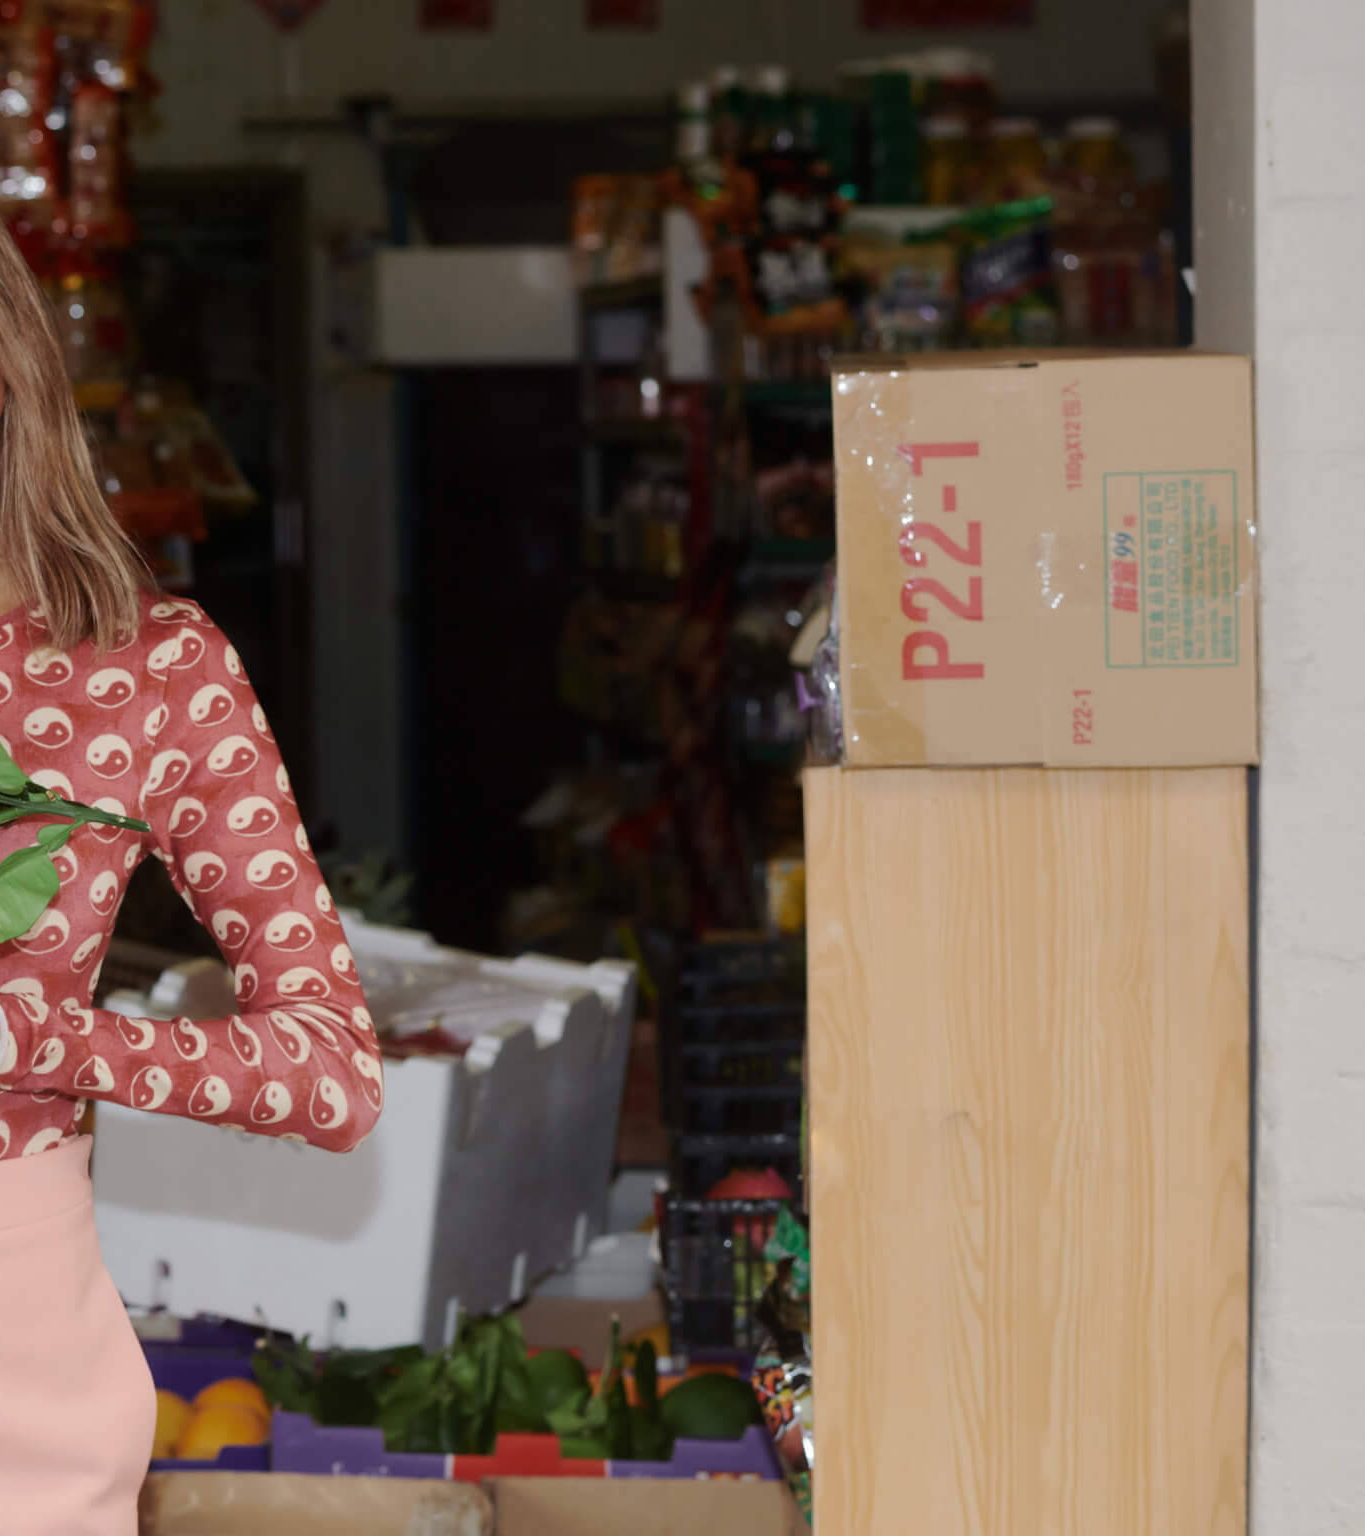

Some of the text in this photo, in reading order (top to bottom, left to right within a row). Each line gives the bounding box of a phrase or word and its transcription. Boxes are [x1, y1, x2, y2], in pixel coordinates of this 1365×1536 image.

[895, 442, 985, 680] P22-1
[1165, 550, 1180, 593] FOOD
[1072, 689, 1093, 745] P22-1
